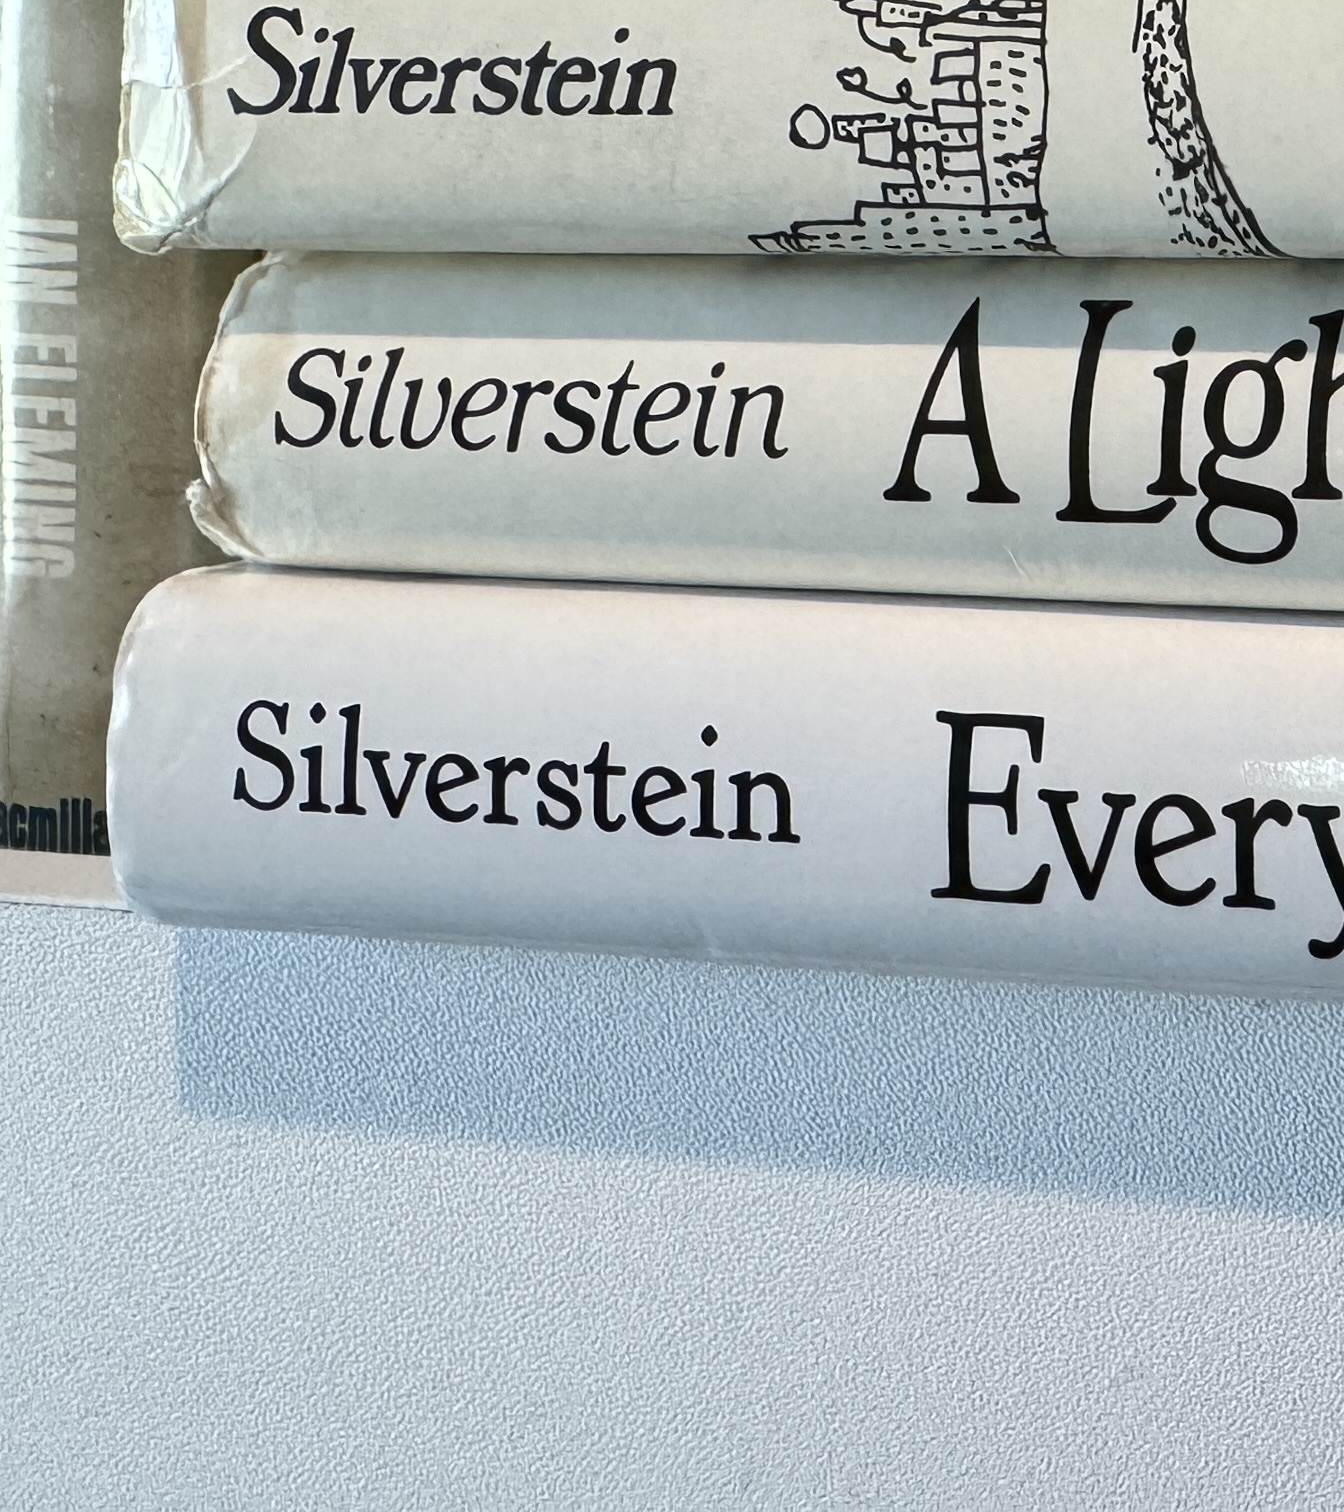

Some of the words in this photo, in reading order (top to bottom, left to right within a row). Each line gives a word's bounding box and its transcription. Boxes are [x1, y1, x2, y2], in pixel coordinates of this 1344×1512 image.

[227, 7, 676, 116] Silverstein
[6, 216, 79, 305] IAN
[8, 334, 78, 579] FLEMING
[275, 348, 788, 459] Silverstein
[883, 297, 1020, 503] A
[234, 700, 800, 843] Silverstein
